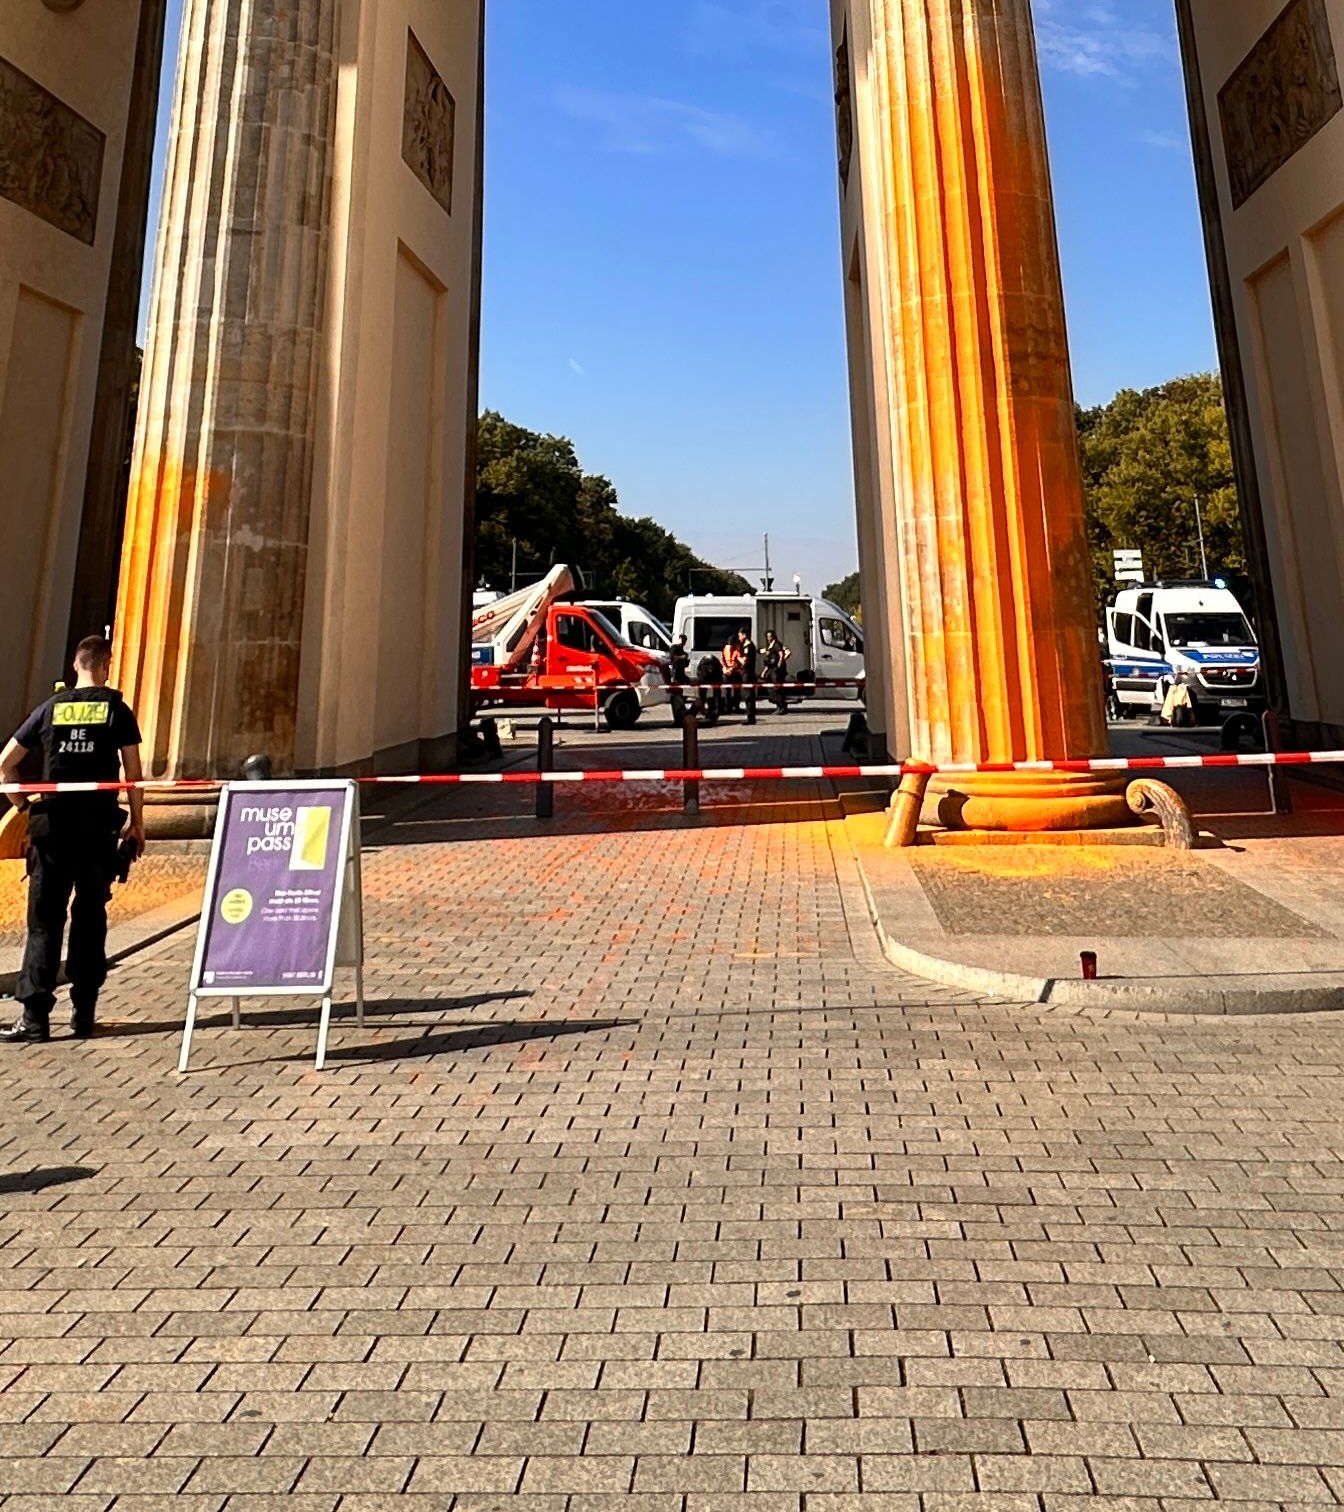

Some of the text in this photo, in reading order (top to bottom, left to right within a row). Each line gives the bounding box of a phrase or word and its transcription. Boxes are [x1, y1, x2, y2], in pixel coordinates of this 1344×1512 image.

[70, 729, 86, 740] BE
[58, 741, 94, 753] 24118
[240, 807, 293, 822] muse
[264, 821, 295, 836] um
[246, 836, 291, 855] pass
